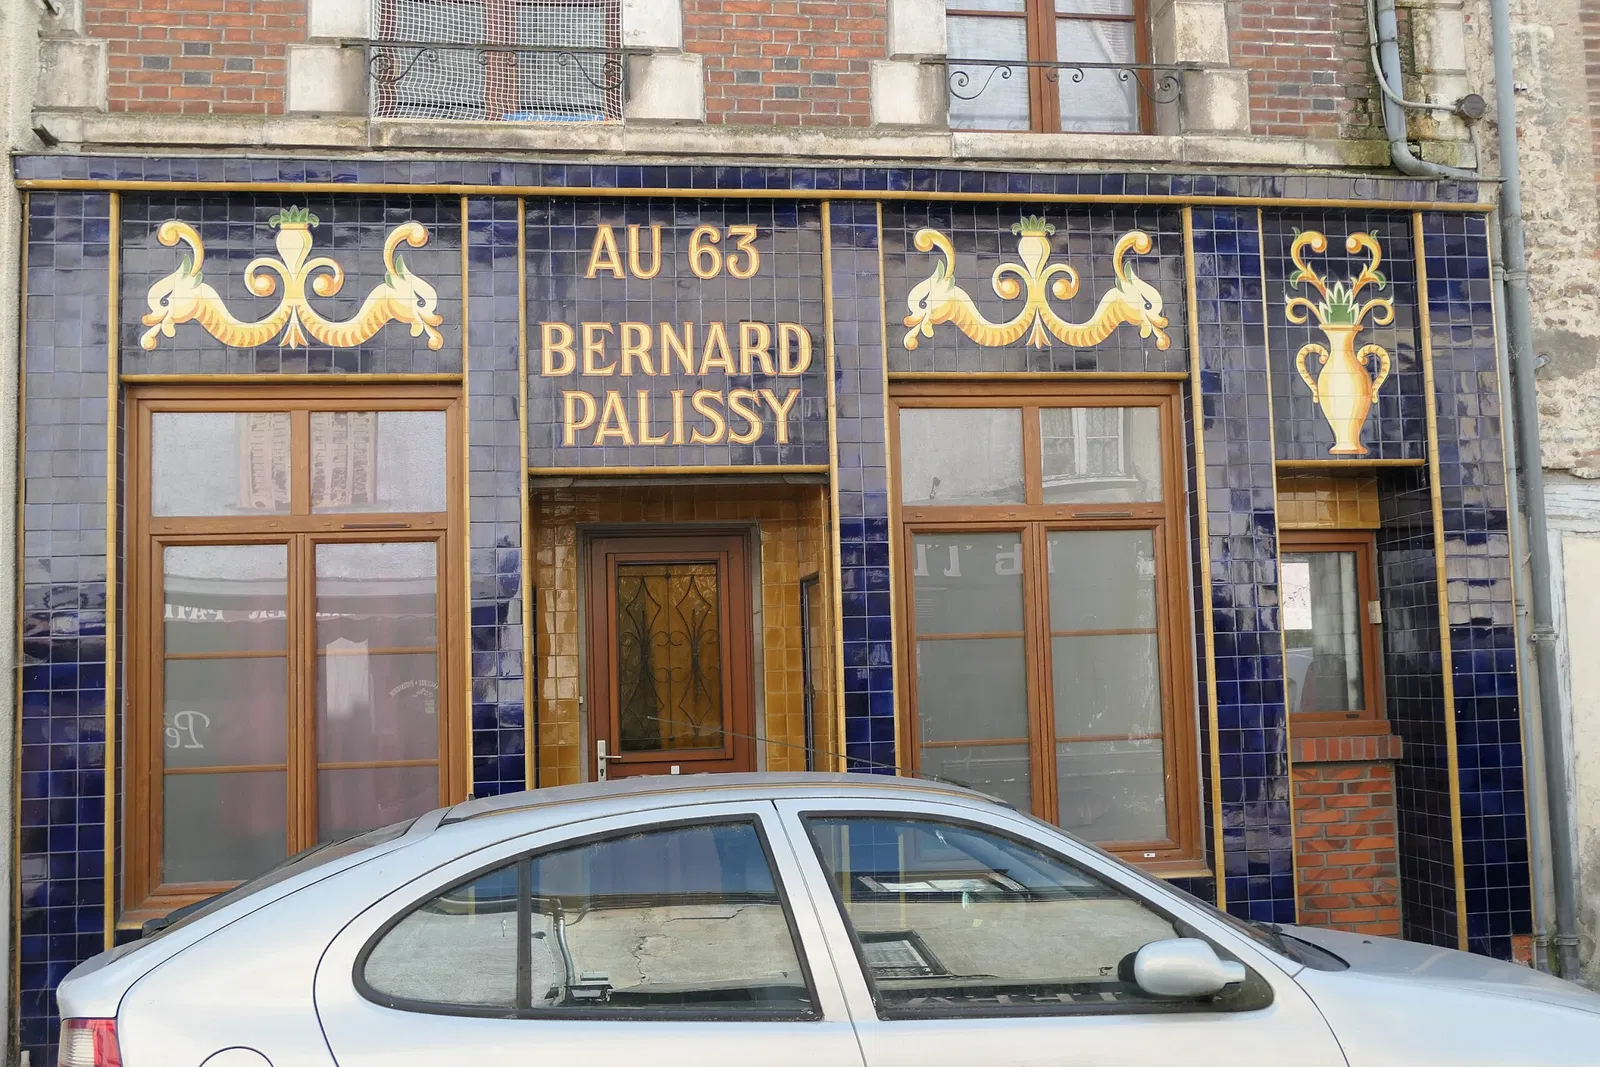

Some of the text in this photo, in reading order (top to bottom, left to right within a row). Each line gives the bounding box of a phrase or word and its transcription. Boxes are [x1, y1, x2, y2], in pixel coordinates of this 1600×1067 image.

[584, 224, 760, 280] AU 63
[539, 320, 813, 378] BERNARD
[562, 387, 801, 447] PALISSY
